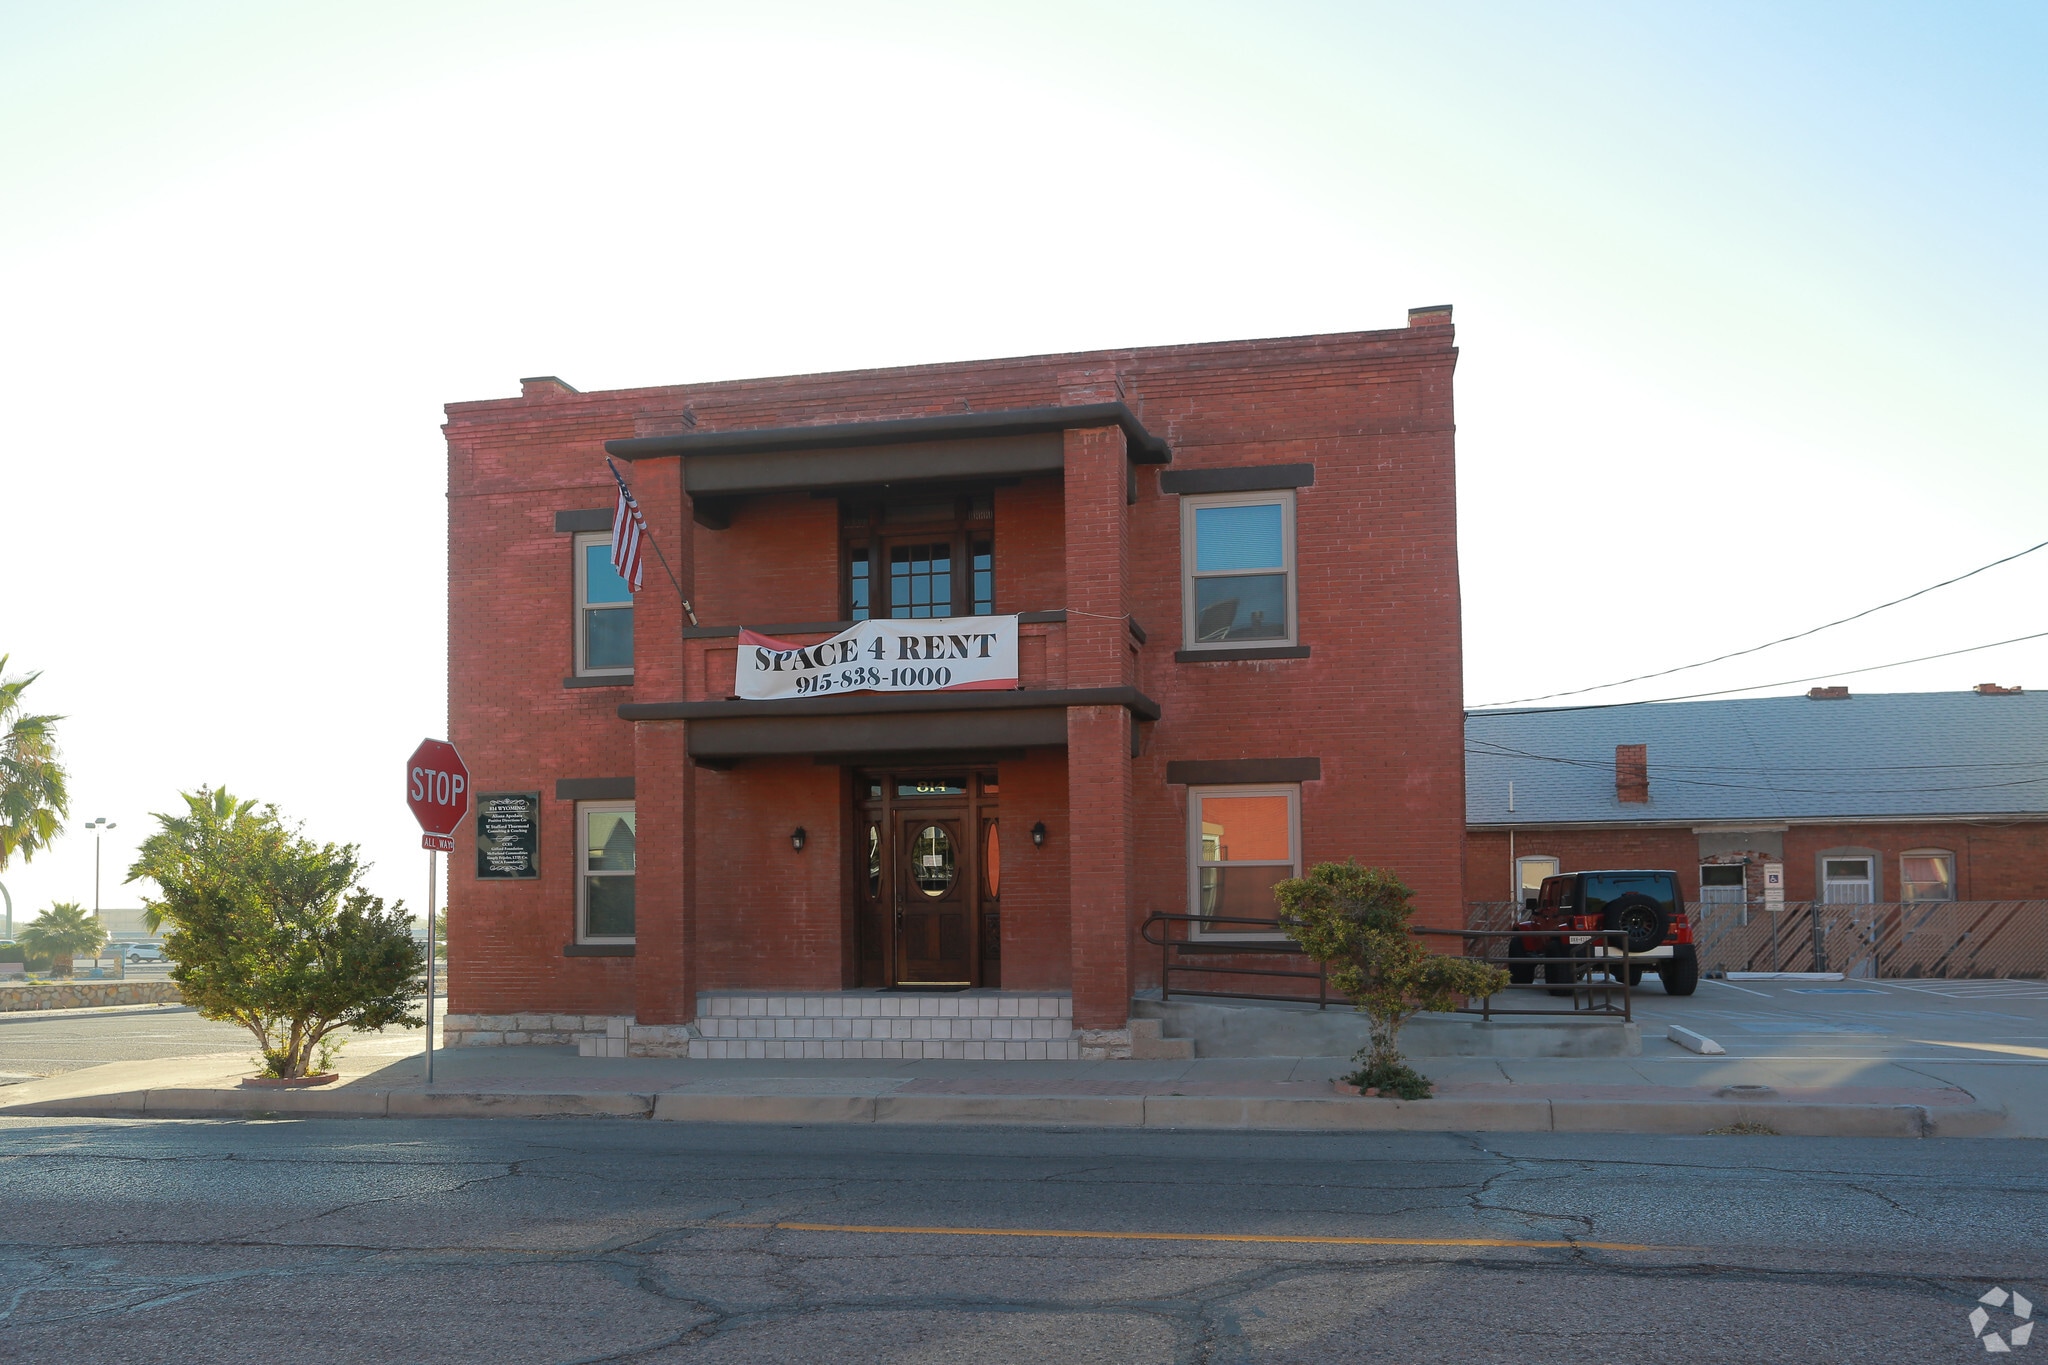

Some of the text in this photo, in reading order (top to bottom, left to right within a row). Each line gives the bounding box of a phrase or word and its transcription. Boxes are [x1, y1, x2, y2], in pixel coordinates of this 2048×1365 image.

[755, 633, 997, 672] SPACE 4 RENT
[795, 666, 952, 694] 915-838-1000
[411, 766, 465, 807] STOP
[916, 781, 946, 792] 814
[424, 837, 452, 849] ALL WAY
